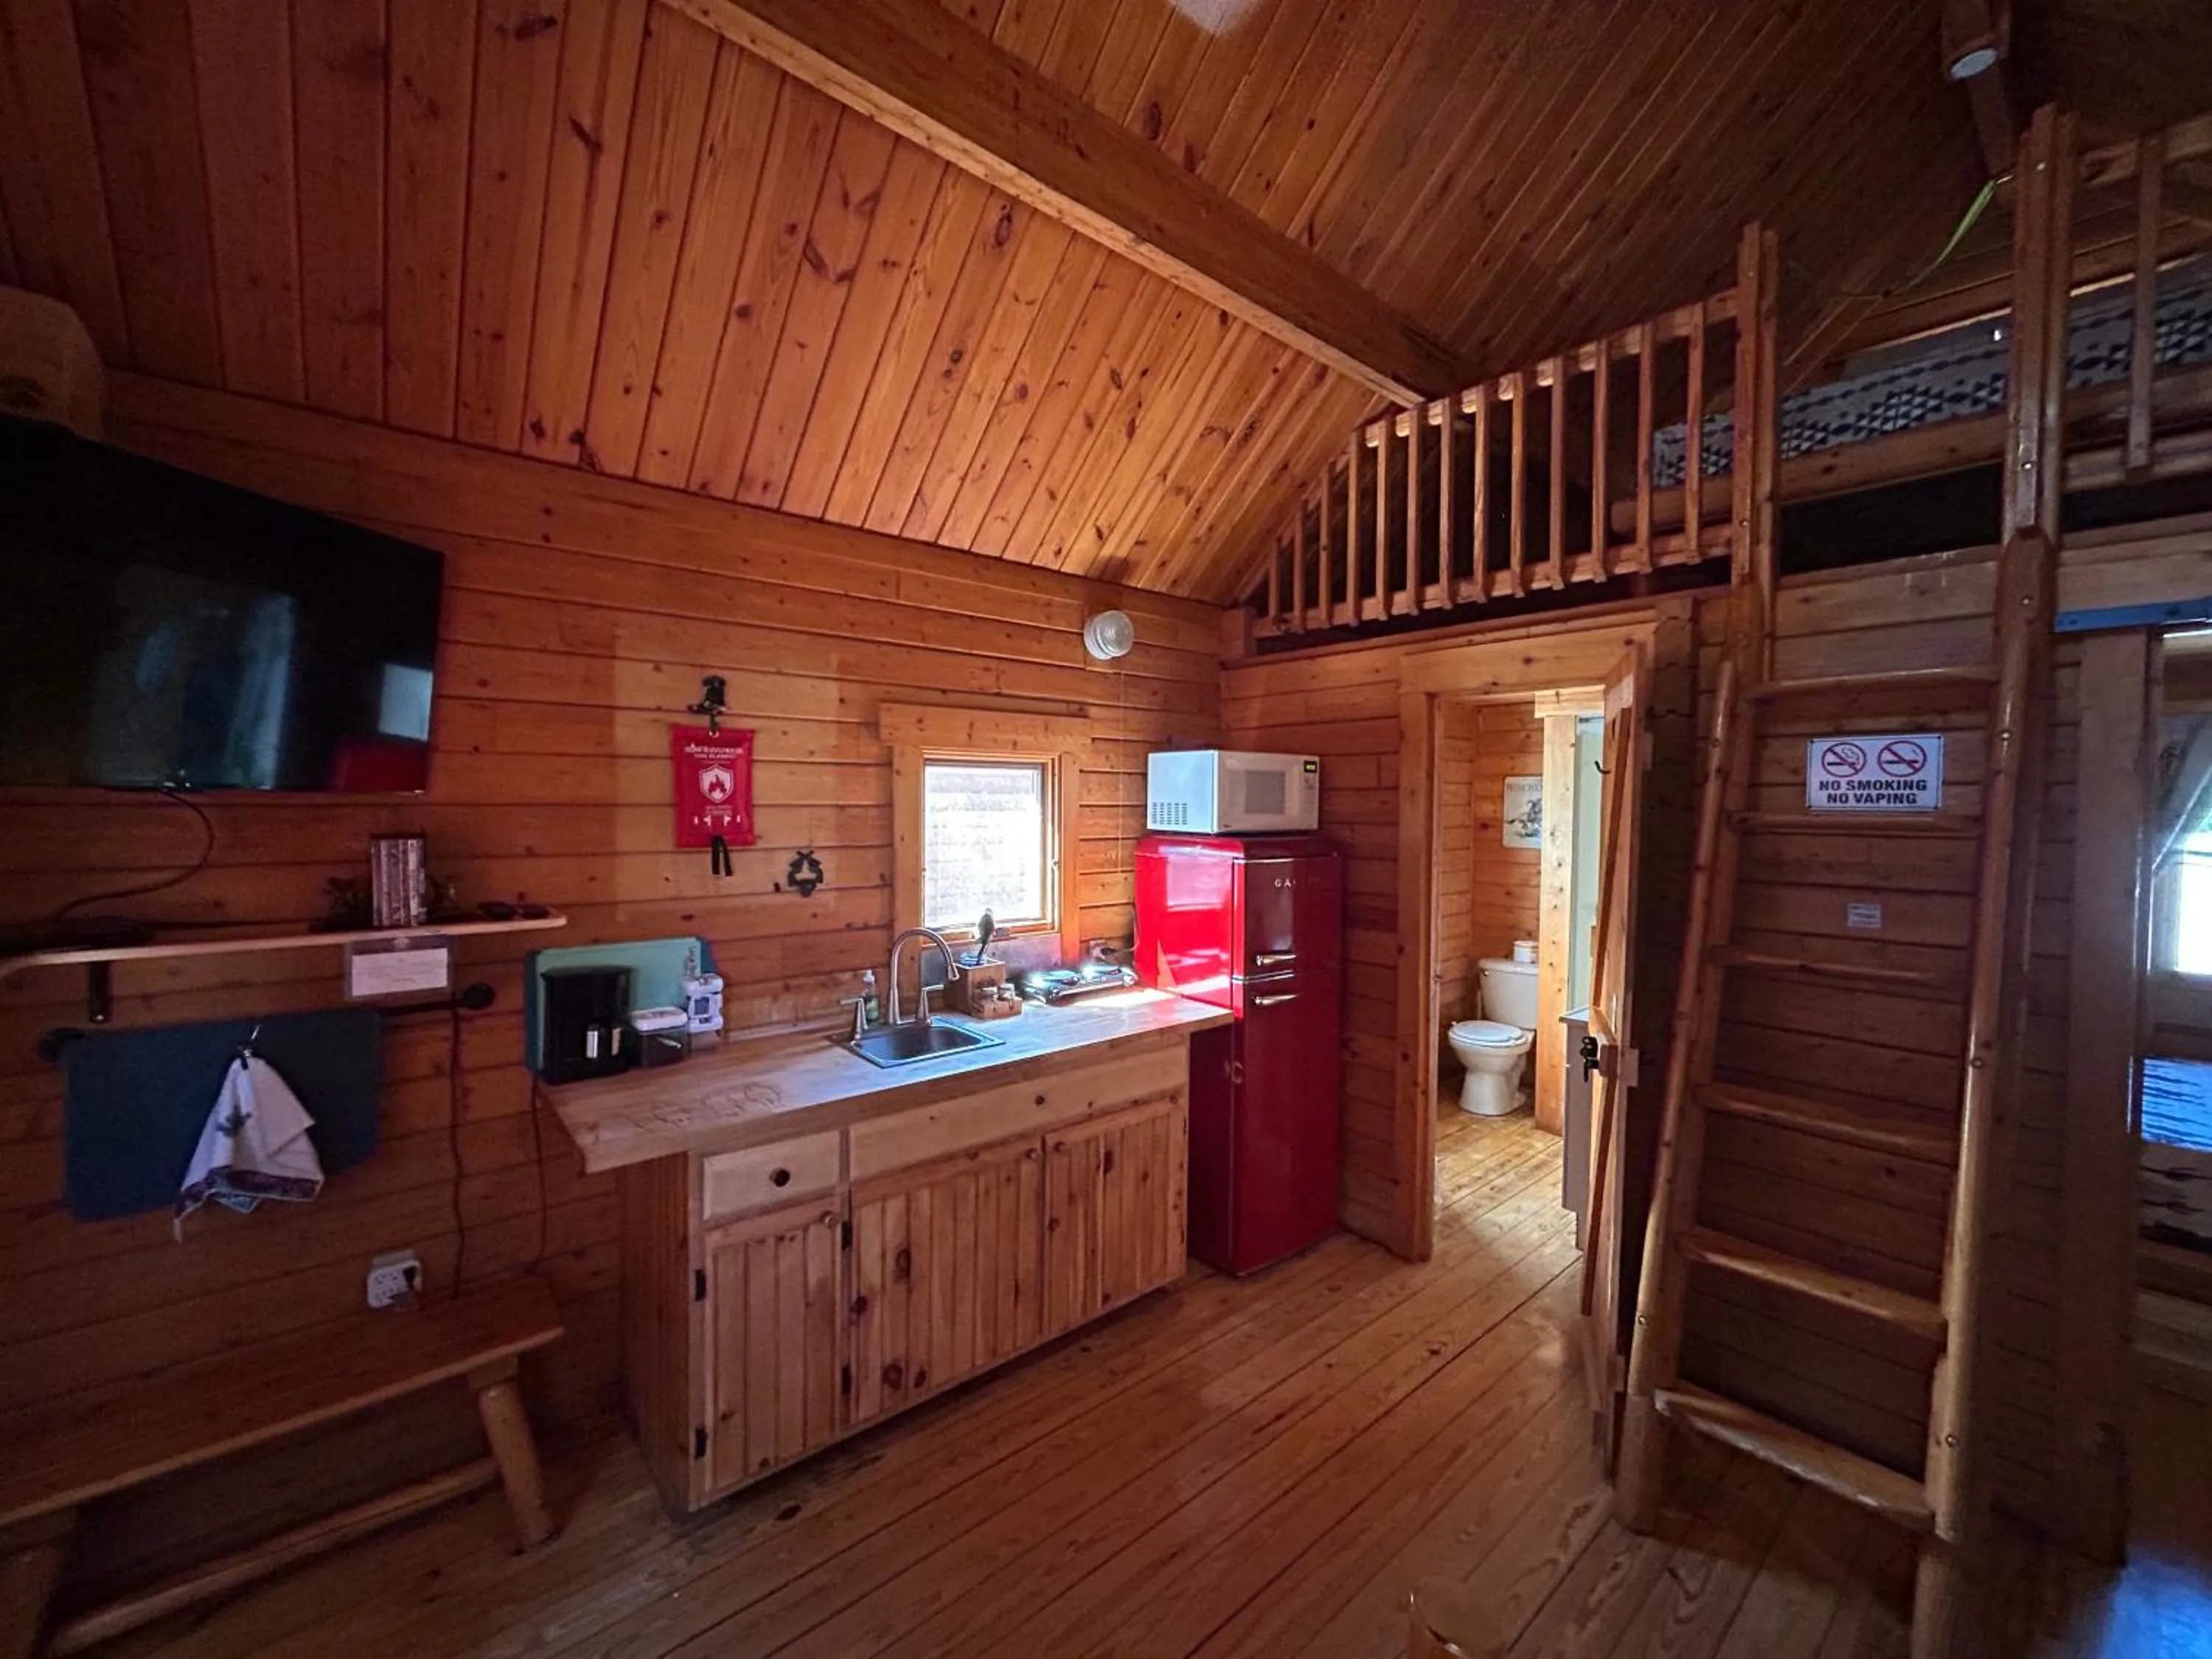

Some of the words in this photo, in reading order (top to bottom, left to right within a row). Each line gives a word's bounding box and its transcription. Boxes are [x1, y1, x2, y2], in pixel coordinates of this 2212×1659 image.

[1819, 779, 1841, 791] NO
[1846, 779, 1927, 791] SMOKING
[1826, 793, 1849, 804] NO
[1854, 792, 1918, 804] VAPING
